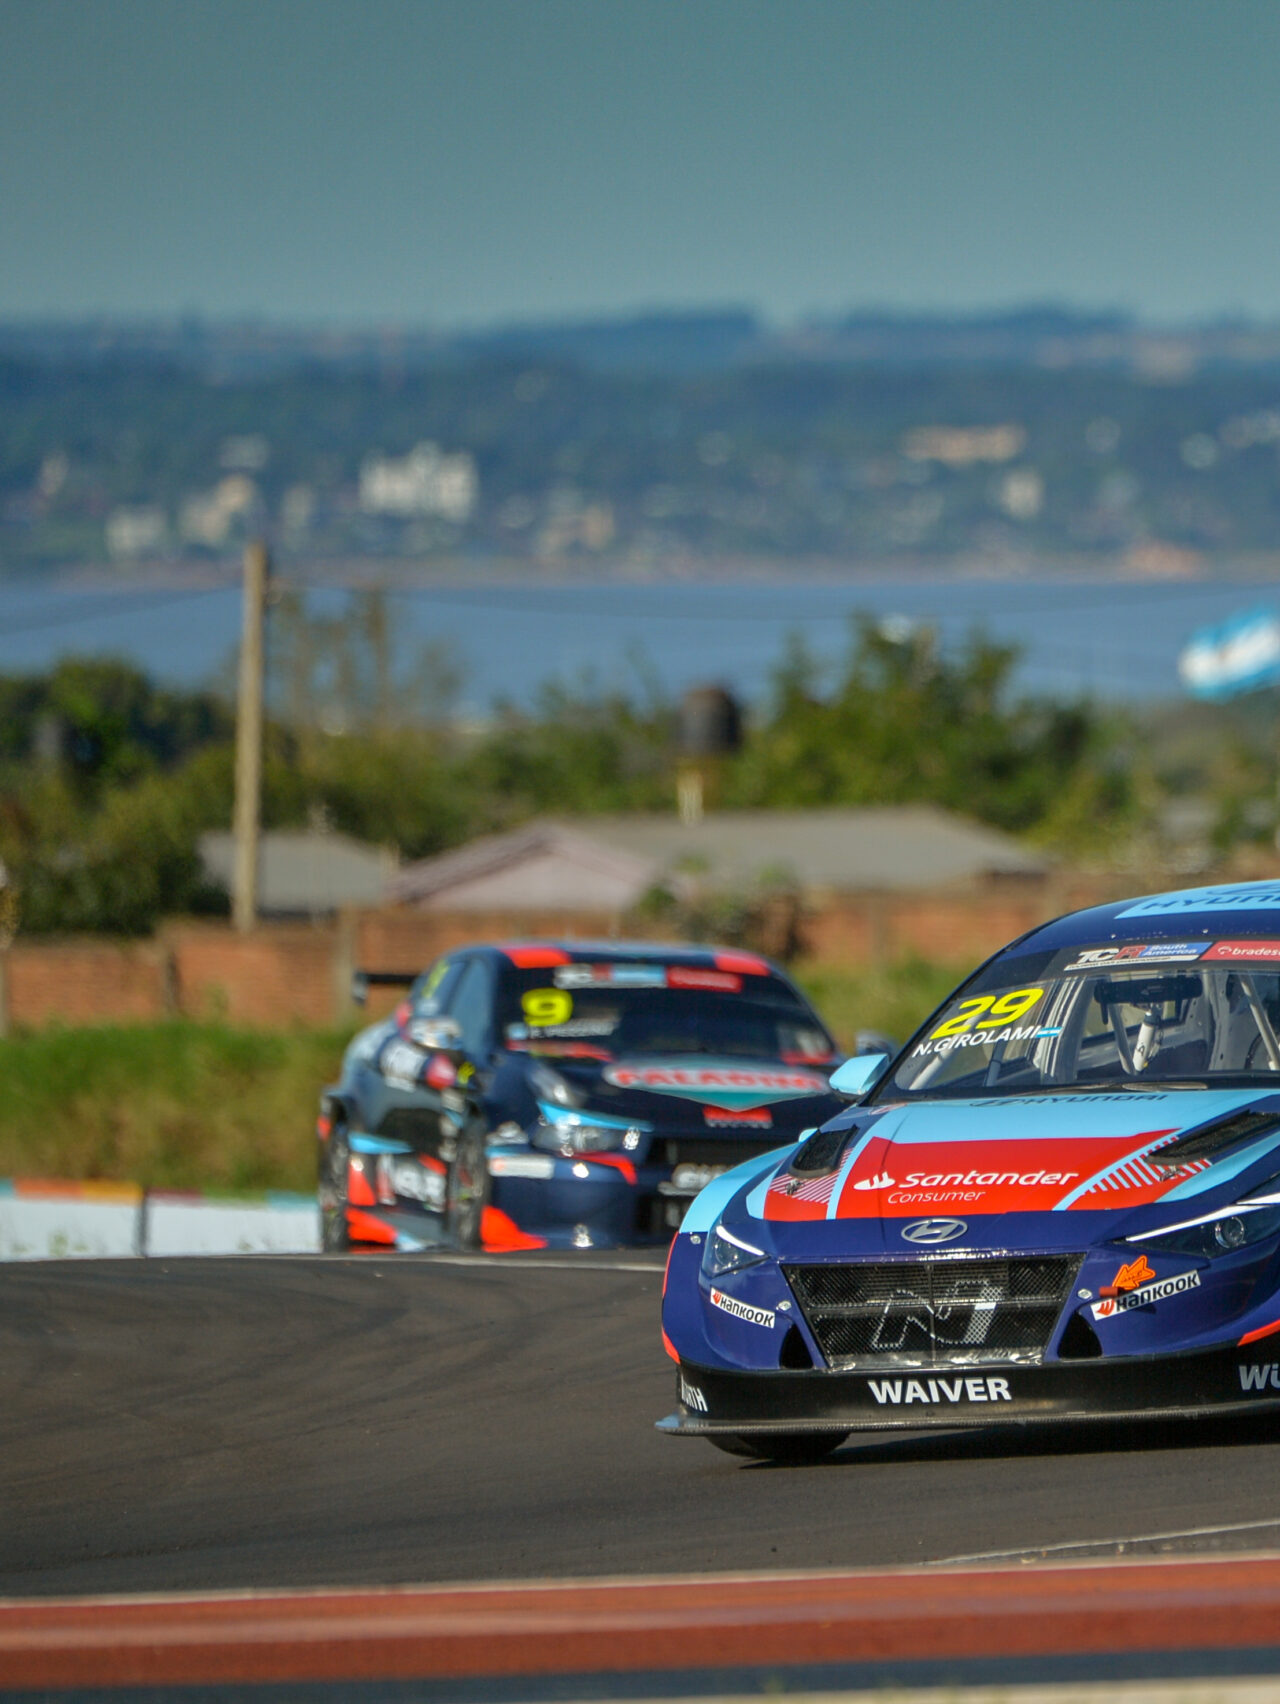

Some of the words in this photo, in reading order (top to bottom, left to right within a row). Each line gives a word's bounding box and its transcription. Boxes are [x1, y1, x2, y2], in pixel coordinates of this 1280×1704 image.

[521, 987, 573, 1027] 9
[930, 988, 1044, 1040] 29
[911, 1025, 1041, 1058] N.GIROLAMI
[898, 1170, 1080, 1188] Santander
[887, 1190, 986, 1204] Consumer
[867, 1377, 1012, 1404] WAIVER
